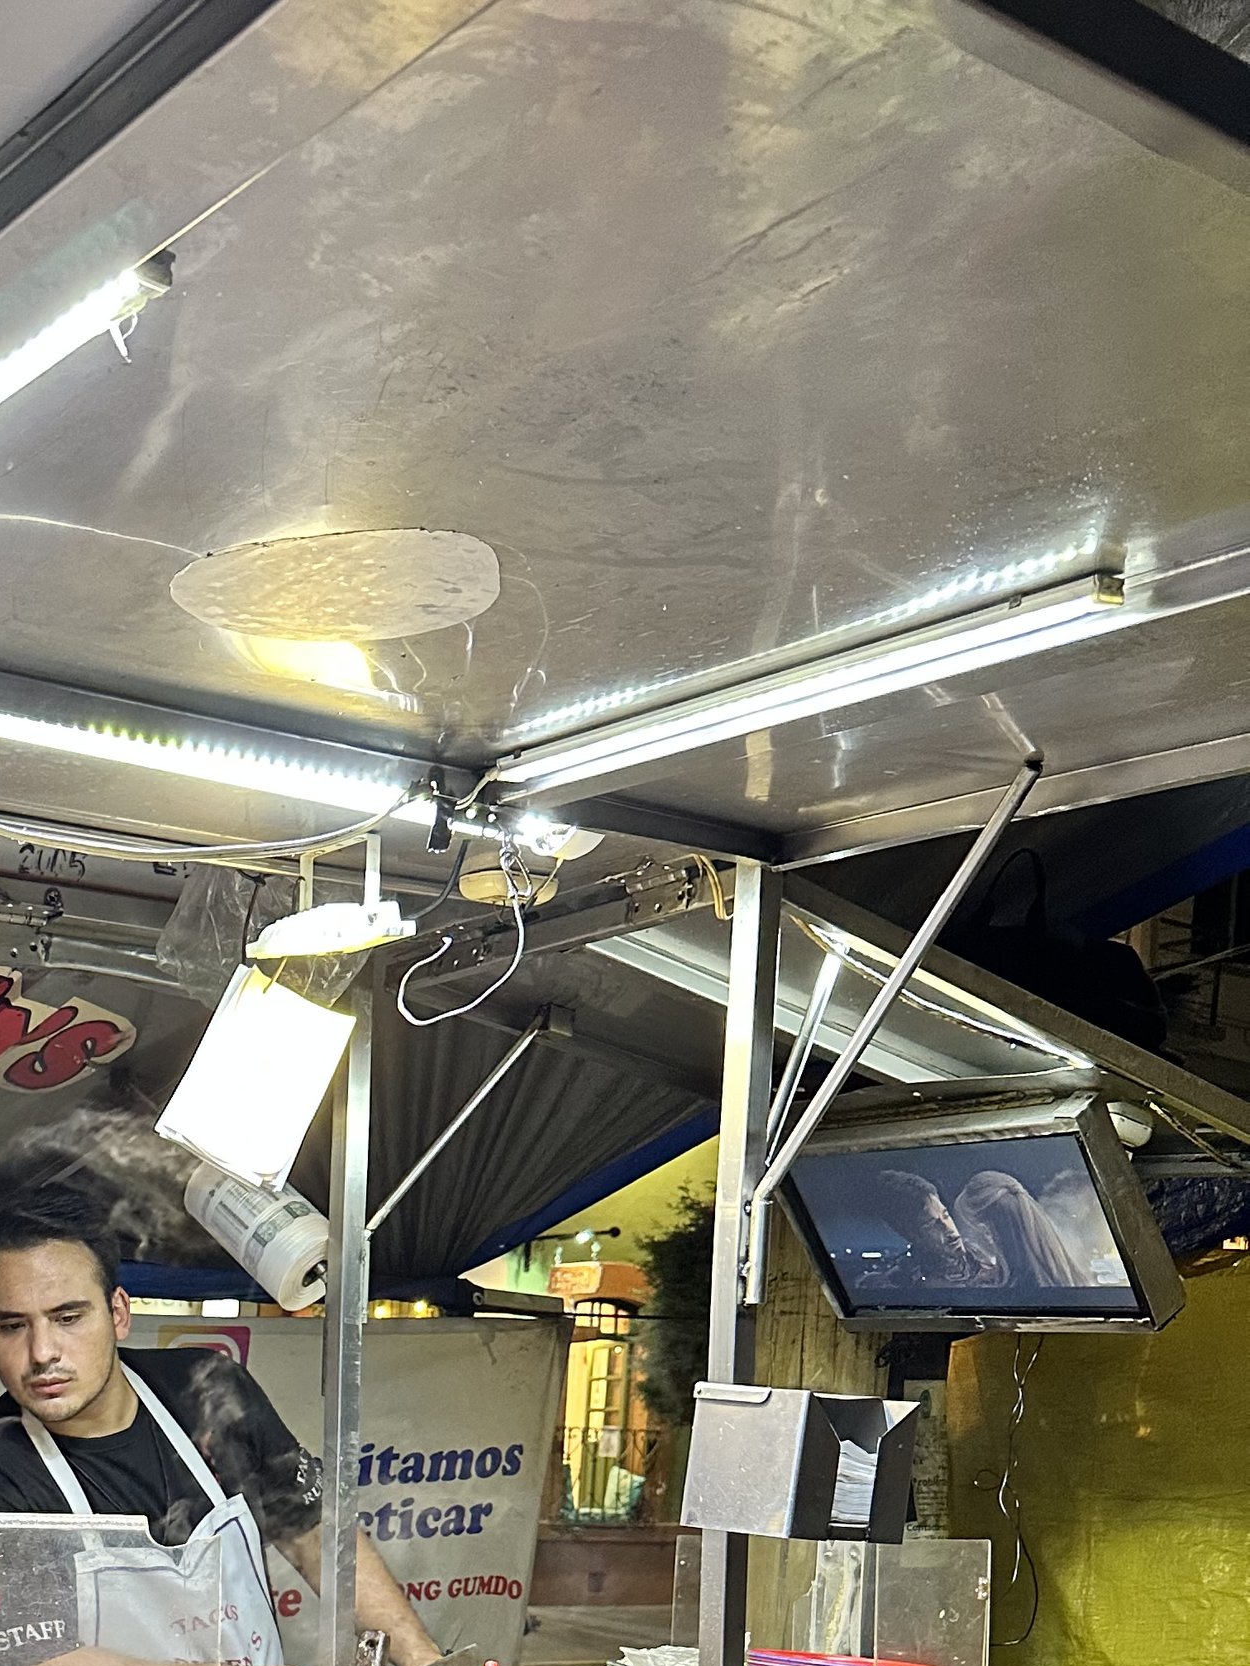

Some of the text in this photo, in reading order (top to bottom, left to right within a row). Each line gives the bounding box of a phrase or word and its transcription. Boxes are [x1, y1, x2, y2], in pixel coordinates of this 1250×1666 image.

[357, 1442, 524, 1486] itamos
[401, 1575, 523, 1600] NG GUMDO
